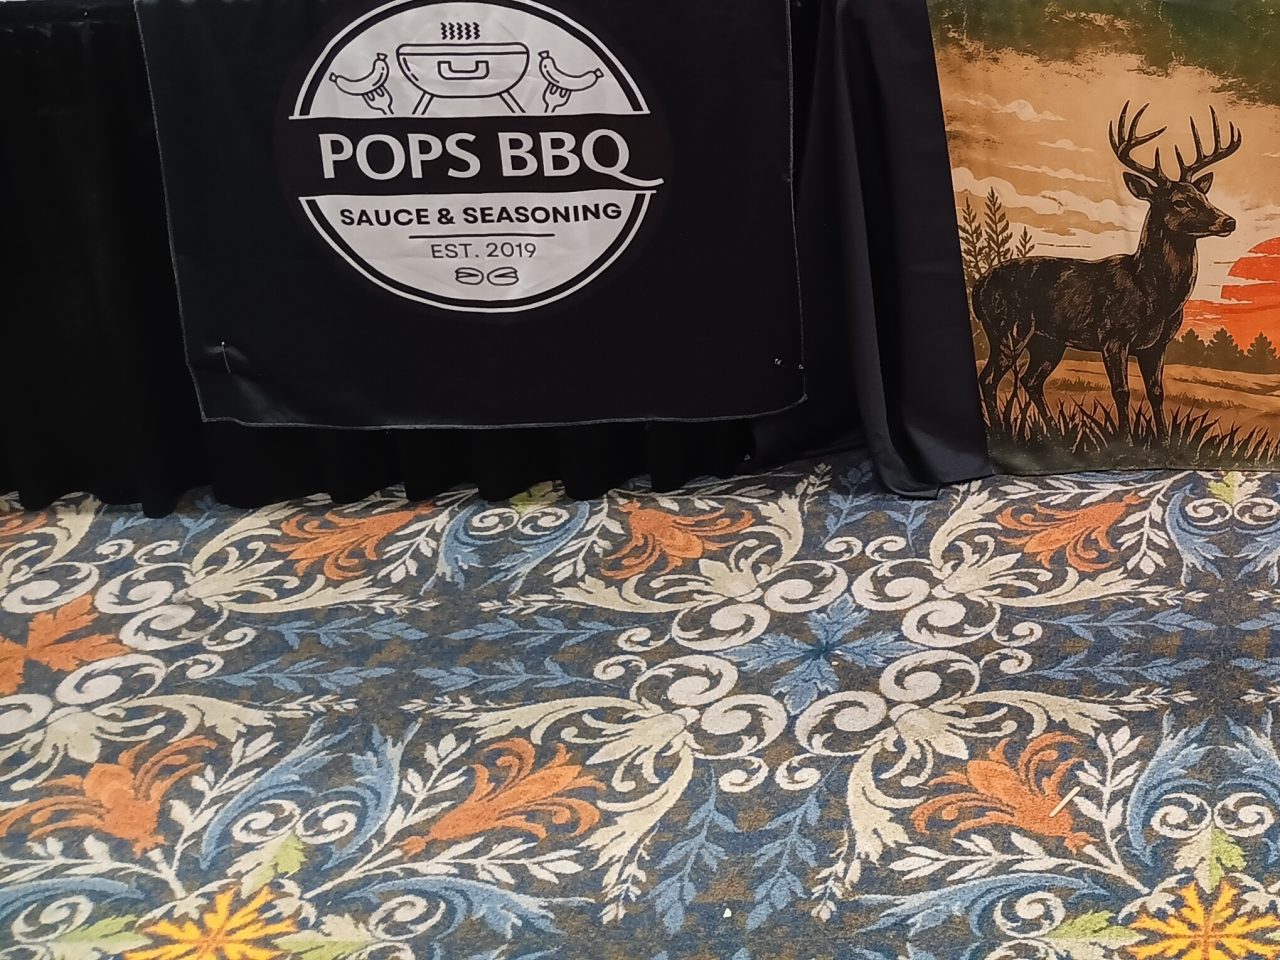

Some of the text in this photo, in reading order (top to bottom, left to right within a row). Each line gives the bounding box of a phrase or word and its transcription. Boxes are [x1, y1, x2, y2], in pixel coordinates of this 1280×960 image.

[318, 129, 664, 187] POPS BBQ
[341, 202, 622, 226] SAUCE & SEASONING
[431, 242, 536, 259] EST. 2019
